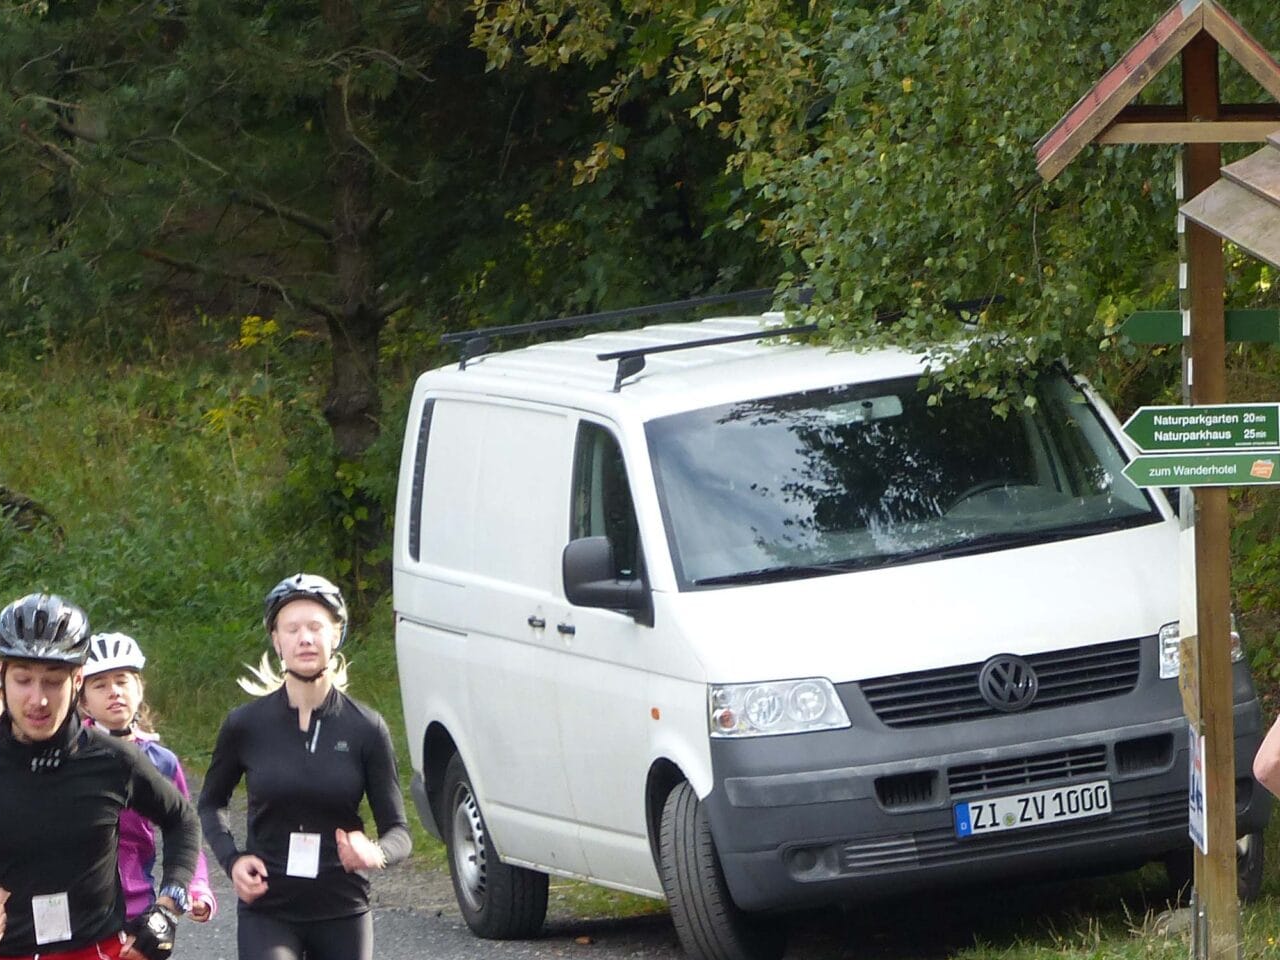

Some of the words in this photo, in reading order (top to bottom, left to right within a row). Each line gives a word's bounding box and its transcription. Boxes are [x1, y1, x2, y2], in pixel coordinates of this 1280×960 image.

[1153, 413, 1239, 426] Naturparkgarten
[1154, 430, 1232, 442] Naturparkhaus
[1149, 467, 1171, 477] zum
[1173, 464, 1237, 476] Wanderhotel
[971, 803, 1000, 830] ZI
[1017, 795, 1045, 822] ZV
[1052, 785, 1109, 817] 1000
